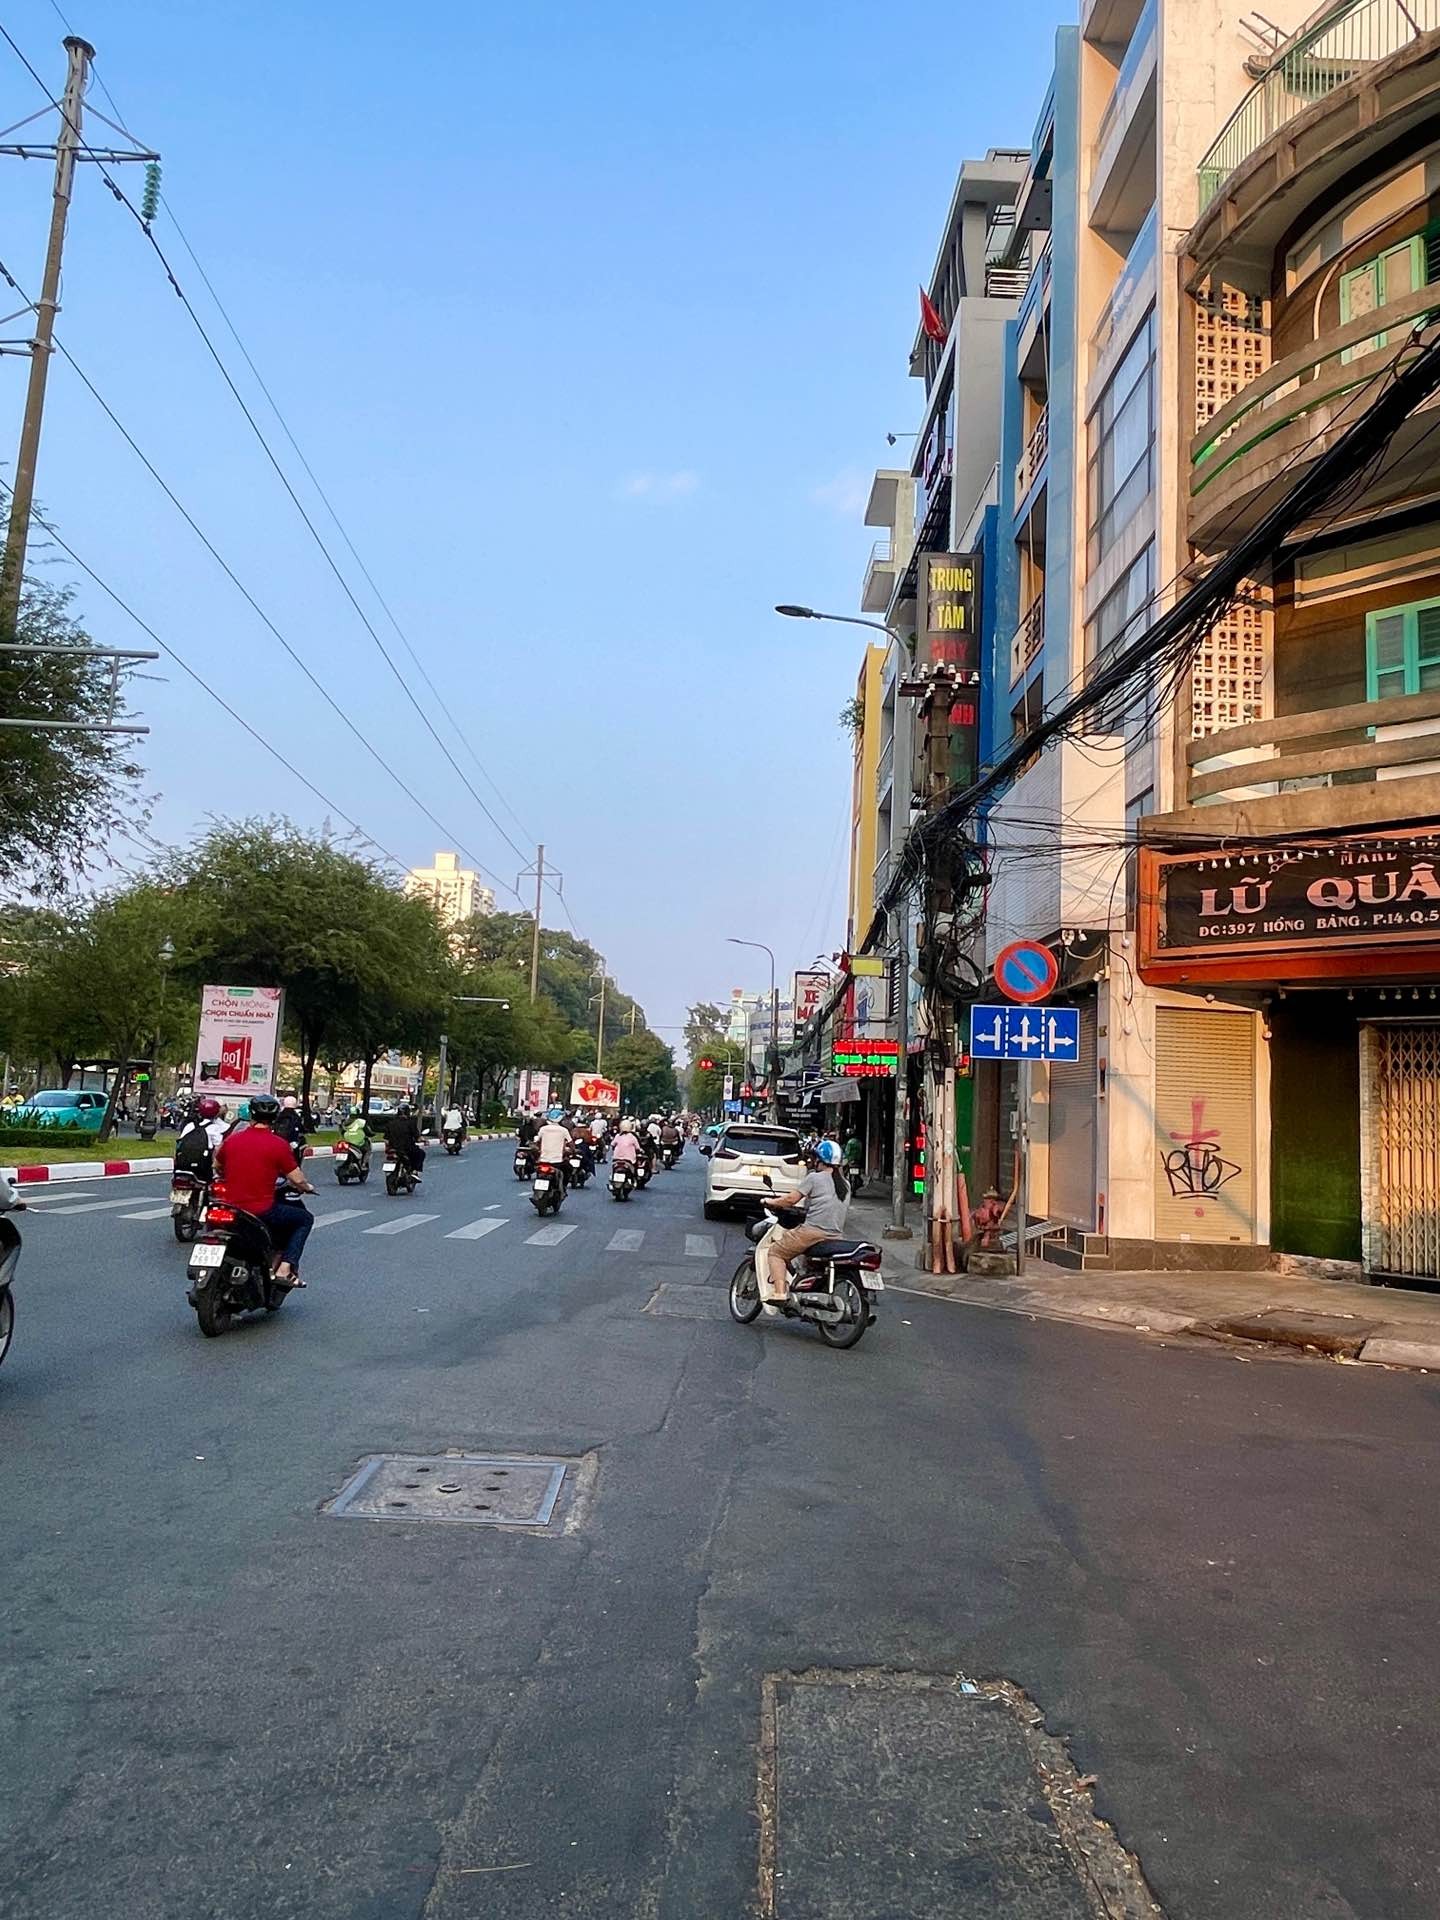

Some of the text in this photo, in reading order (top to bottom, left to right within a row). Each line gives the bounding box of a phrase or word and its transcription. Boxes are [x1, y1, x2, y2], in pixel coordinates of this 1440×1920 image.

[930, 567, 973, 593] TRUNG
[937, 601, 965, 630] TÂM
[1263, 916, 1305, 933] HỒNG
